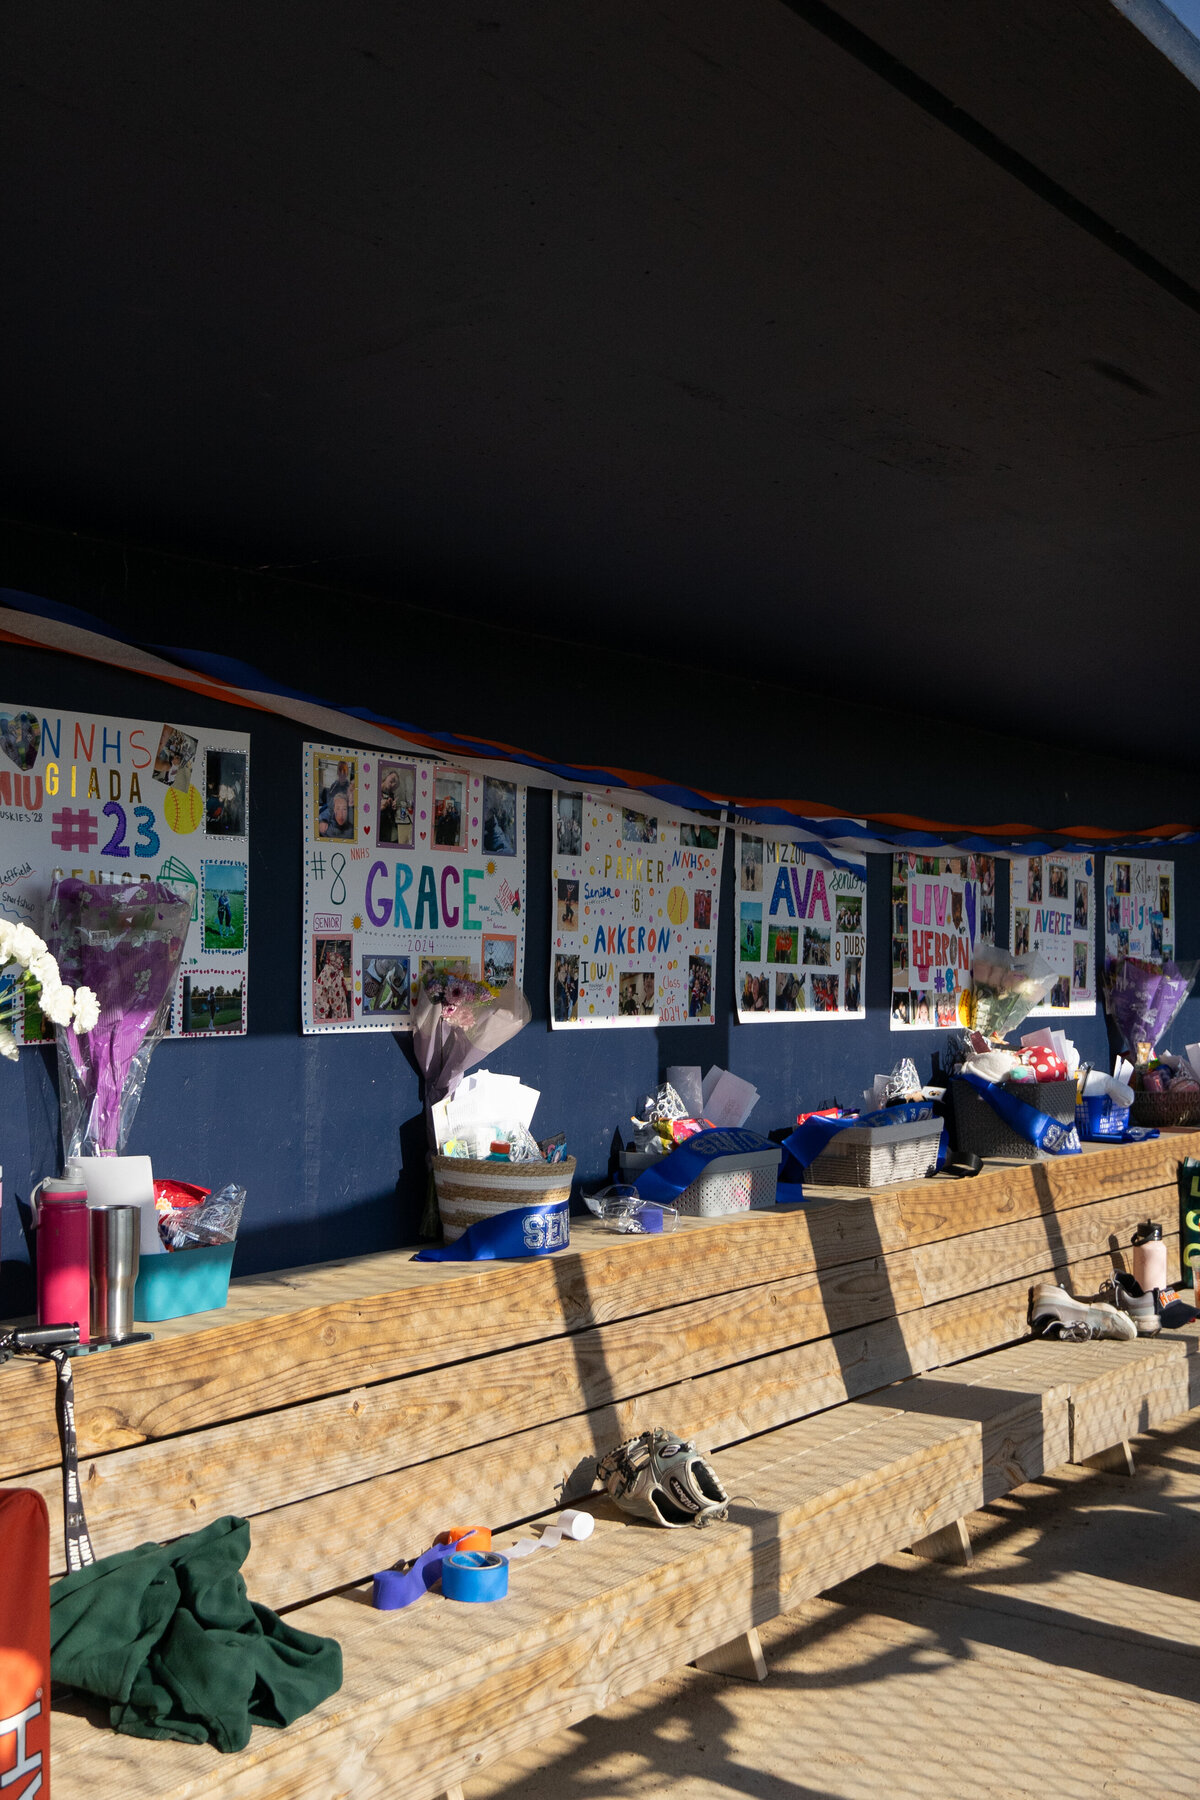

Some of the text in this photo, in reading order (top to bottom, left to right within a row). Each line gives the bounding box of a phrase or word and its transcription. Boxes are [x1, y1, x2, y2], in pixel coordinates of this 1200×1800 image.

[45, 762, 142, 803] GIADA
[51, 801, 161, 858] #23
[350, 847, 370, 860] NNHS
[672, 850, 705, 871] NNHS
[310, 851, 347, 905] #8
[604, 854, 664, 884] PARKER
[365, 860, 485, 931] GRACE
[634, 889, 641, 912] 6
[769, 866, 831, 921] AVA
[315, 917, 340, 930] SENIOR
[1034, 909, 1073, 935] AVERIE
[407, 939, 435, 954] 2024
[594, 923, 671, 955] AKKERON
[844, 935, 866, 956] DUBS
[580, 961, 614, 984] IOWA
[658, 1005, 681, 1022] 2024
[68, 1469, 78, 1503] ARMY
[68, 1538, 82, 1571] ARMY
